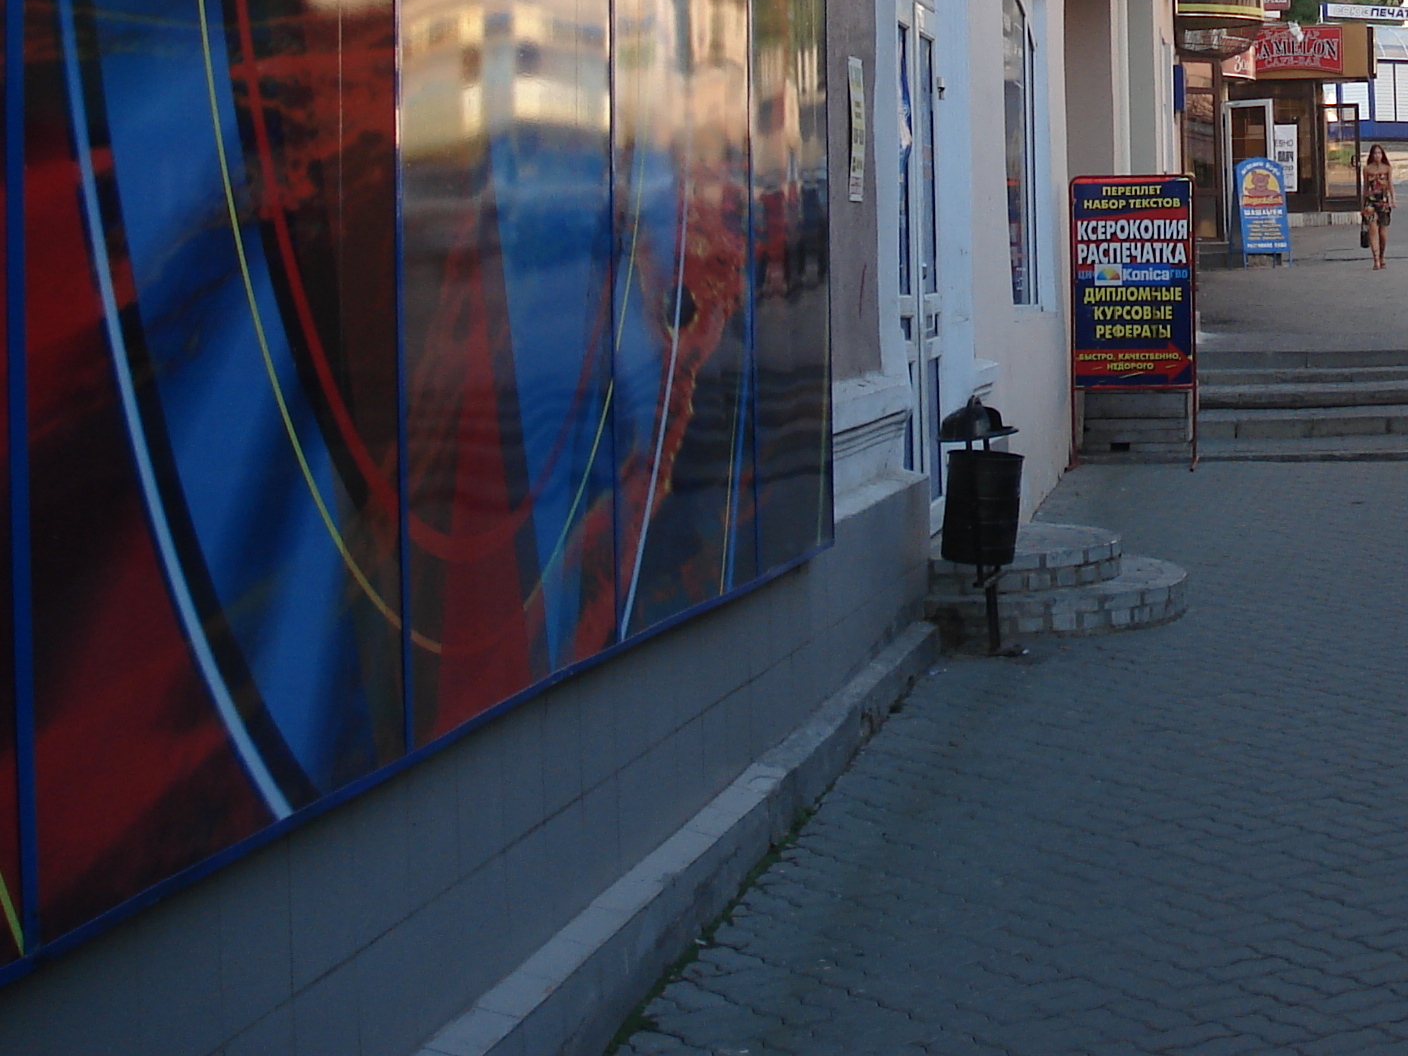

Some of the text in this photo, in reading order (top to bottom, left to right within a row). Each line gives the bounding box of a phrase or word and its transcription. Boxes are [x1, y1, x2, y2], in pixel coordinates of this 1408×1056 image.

[1102, 185, 1162, 196] ПЕРЕПЛЕТ
[1083, 198, 1181, 209] НАБОР ТЕКСТОВ
[1077, 219, 1188, 241] КСЕРОКОПИЯ
[1077, 242, 1187, 264] РАСПЕЧАТКА
[1122, 267, 1170, 281] Konica
[1083, 287, 1182, 304] ДИПЛОМНЫЕ
[1094, 306, 1173, 320] КУРСОВЫЕ
[1096, 324, 1171, 338] РЕФЕРАТЫ
